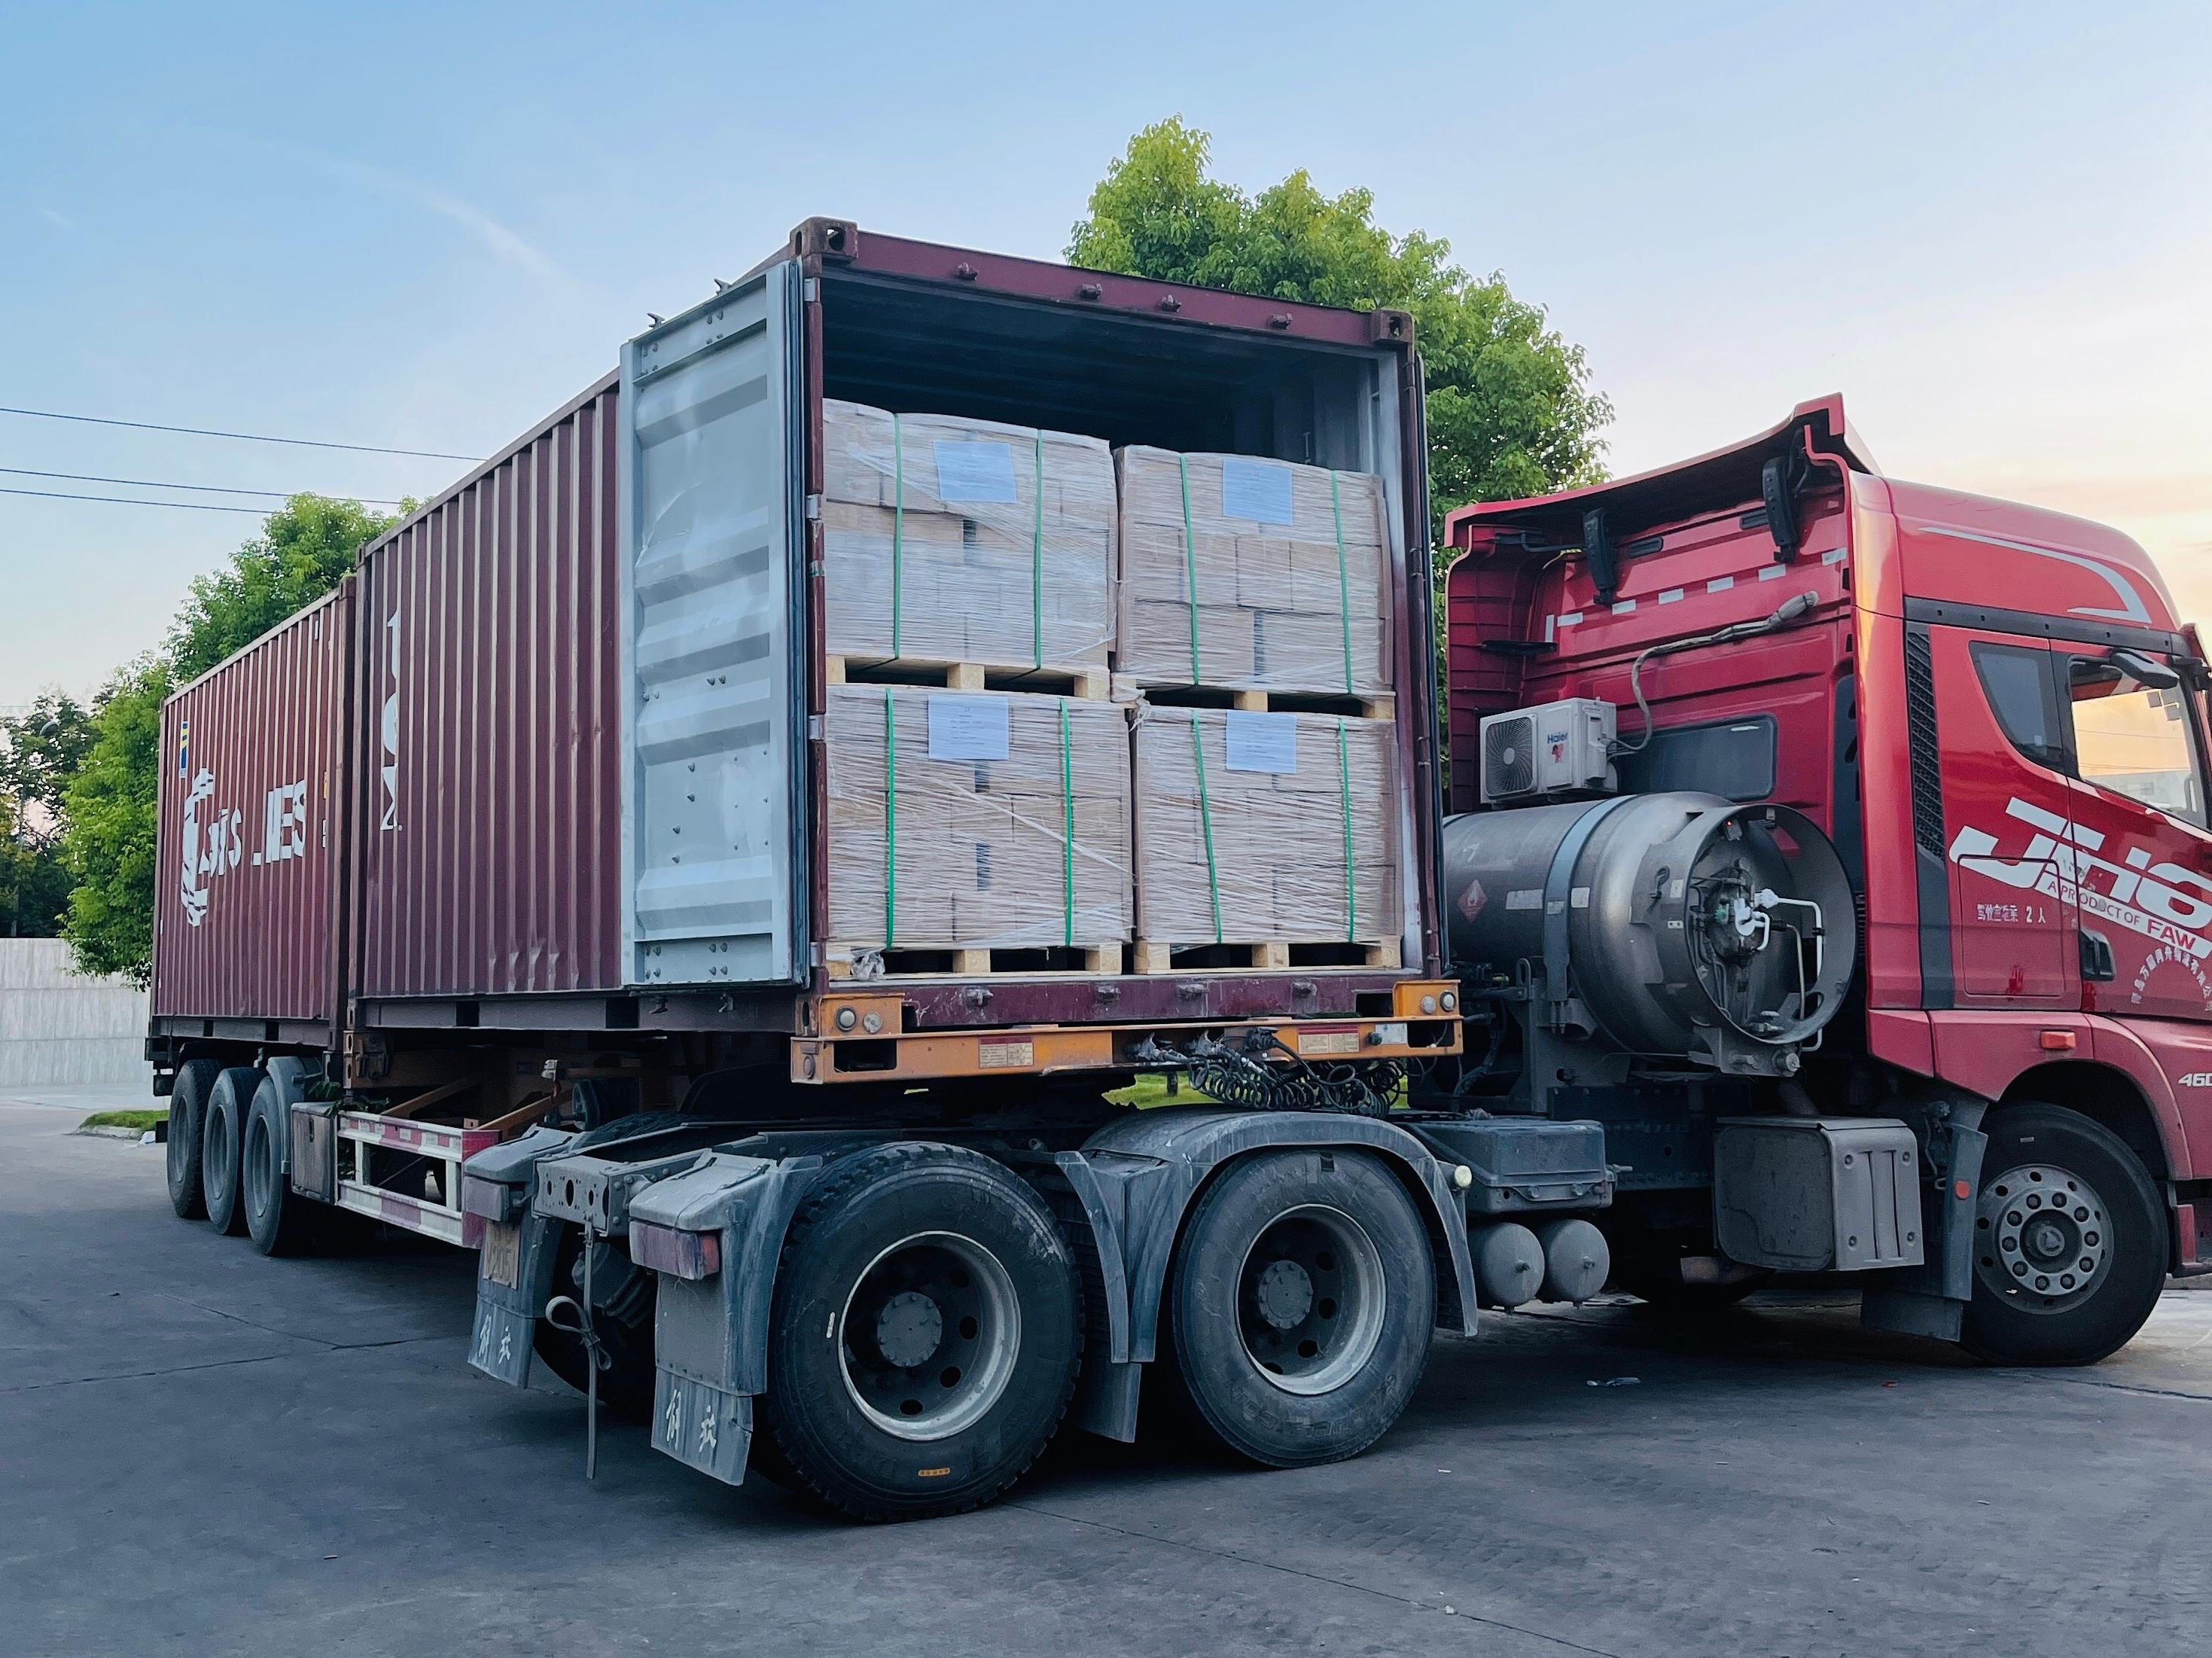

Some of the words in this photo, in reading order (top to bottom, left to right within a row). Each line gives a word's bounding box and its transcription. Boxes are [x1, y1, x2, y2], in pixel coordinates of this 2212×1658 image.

[1546, 731, 1568, 745] Haier
[2047, 881, 2057, 893] A
[2060, 885, 2122, 919] PRODUCT
[2124, 912, 2141, 925] OF
[2146, 918, 2196, 950] FAW
